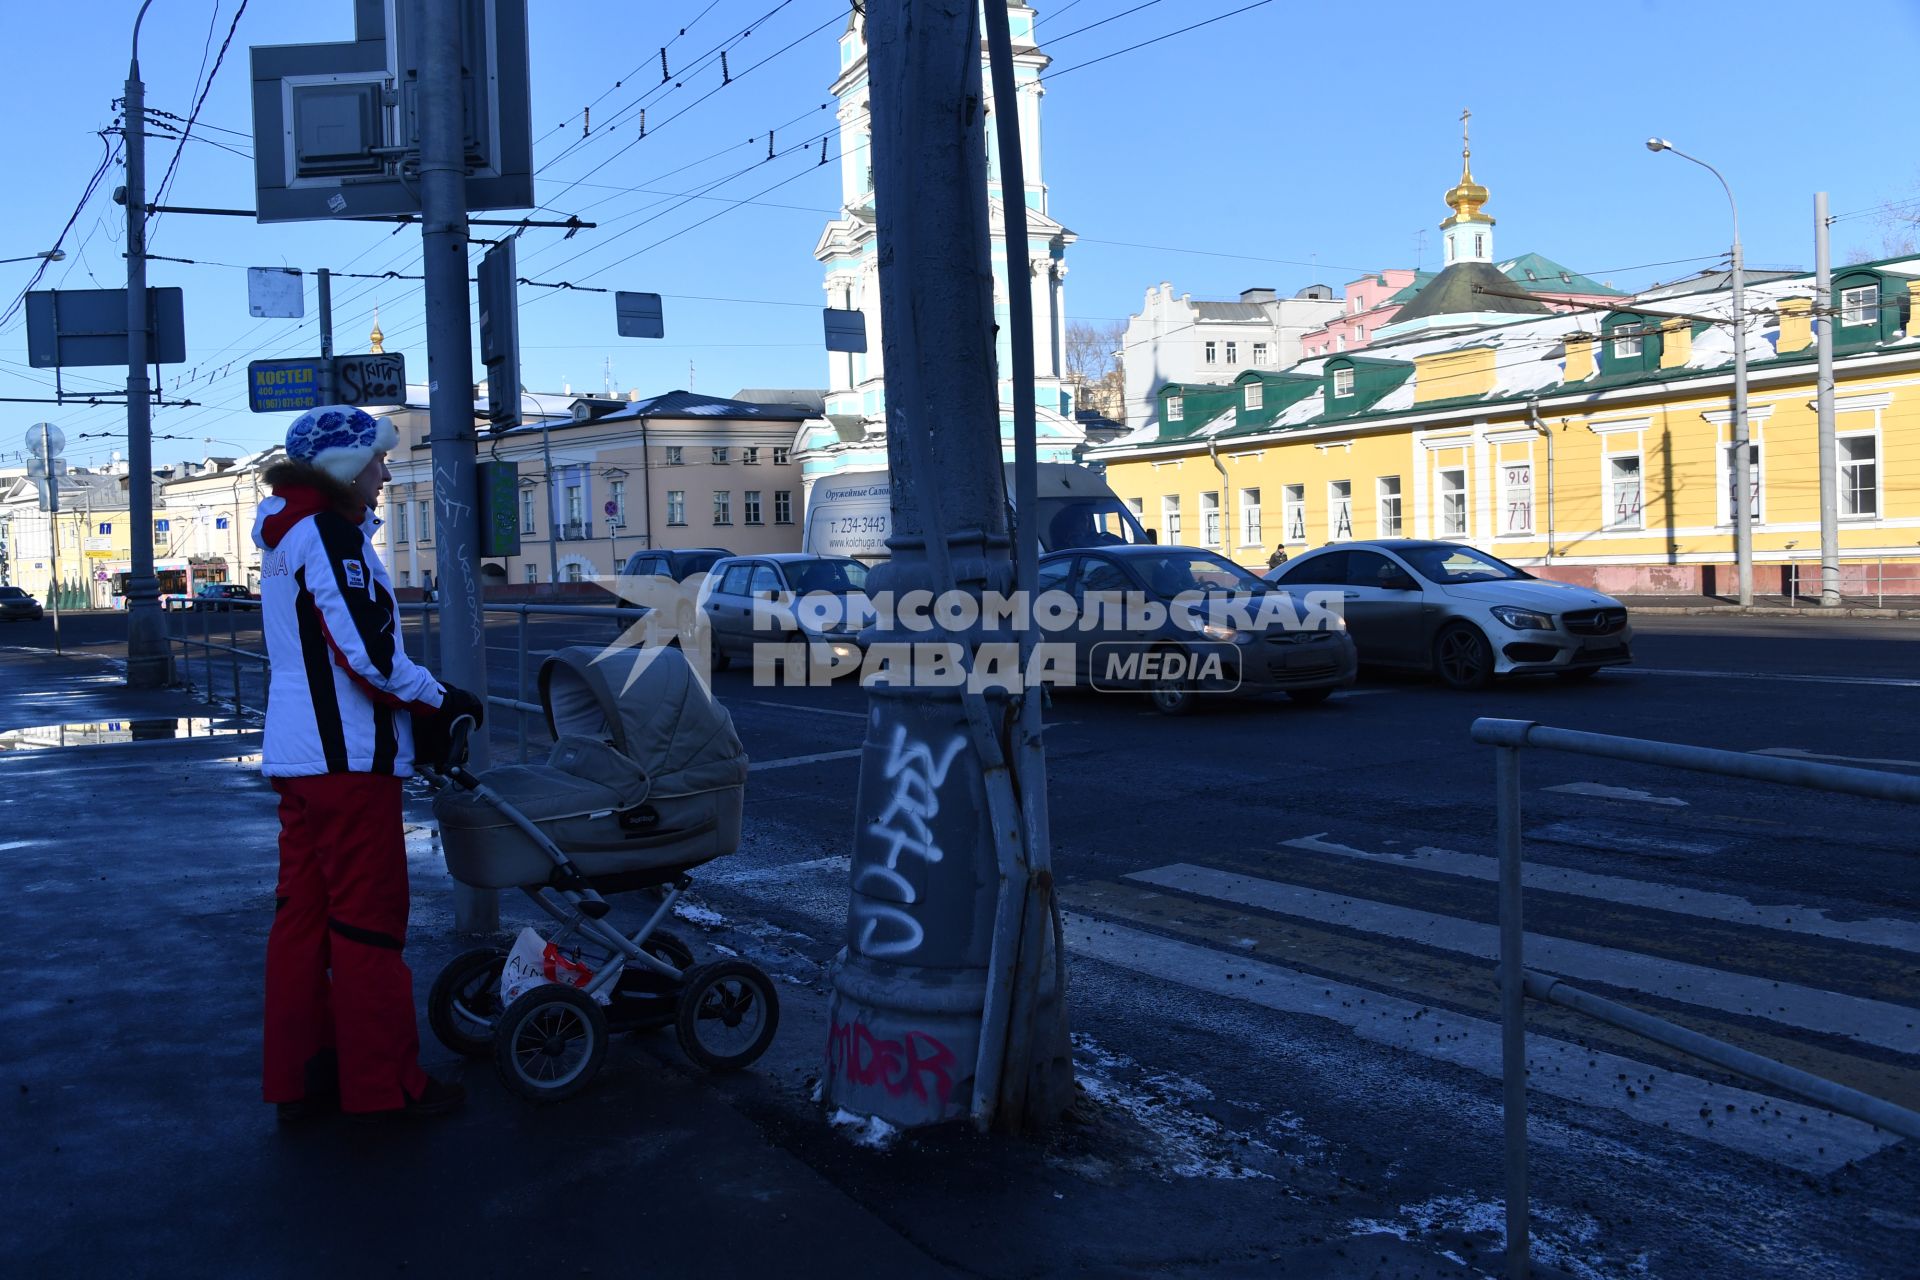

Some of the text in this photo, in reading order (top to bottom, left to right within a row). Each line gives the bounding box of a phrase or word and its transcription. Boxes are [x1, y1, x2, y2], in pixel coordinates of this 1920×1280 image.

[256, 368, 313, 386] ХОСТЕЛ
[1508, 470, 1530, 485] 916
[825, 488, 868, 501] Оружейные
[841, 516, 886, 534] 234-3443
[829, 536, 885, 550] www.kolchuga.ru
